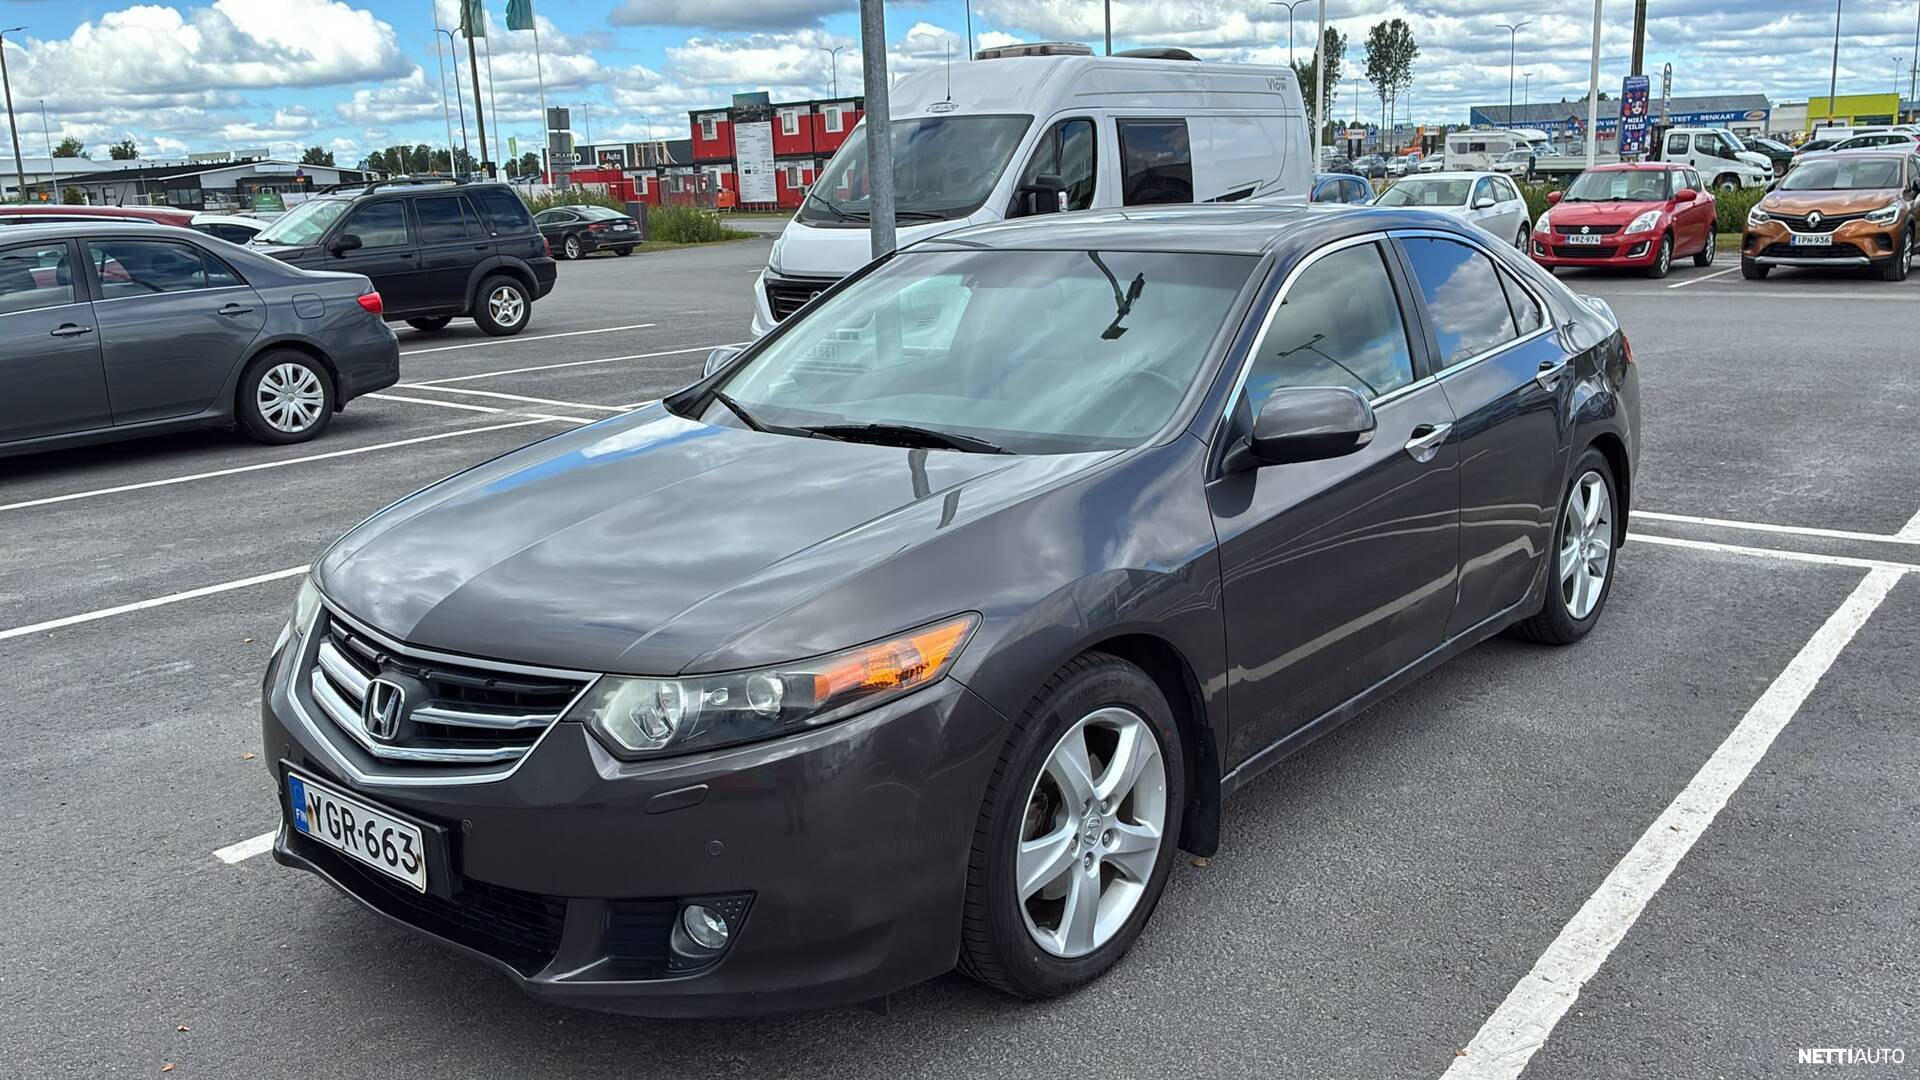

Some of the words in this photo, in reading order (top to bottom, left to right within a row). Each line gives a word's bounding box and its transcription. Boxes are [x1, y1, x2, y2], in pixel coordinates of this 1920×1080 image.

[1650, 115, 1691, 123] VASTEET
[1700, 113, 1735, 121] RENKAAT
[296, 808, 307, 822] FIN
[309, 792, 418, 874] YGR-663
